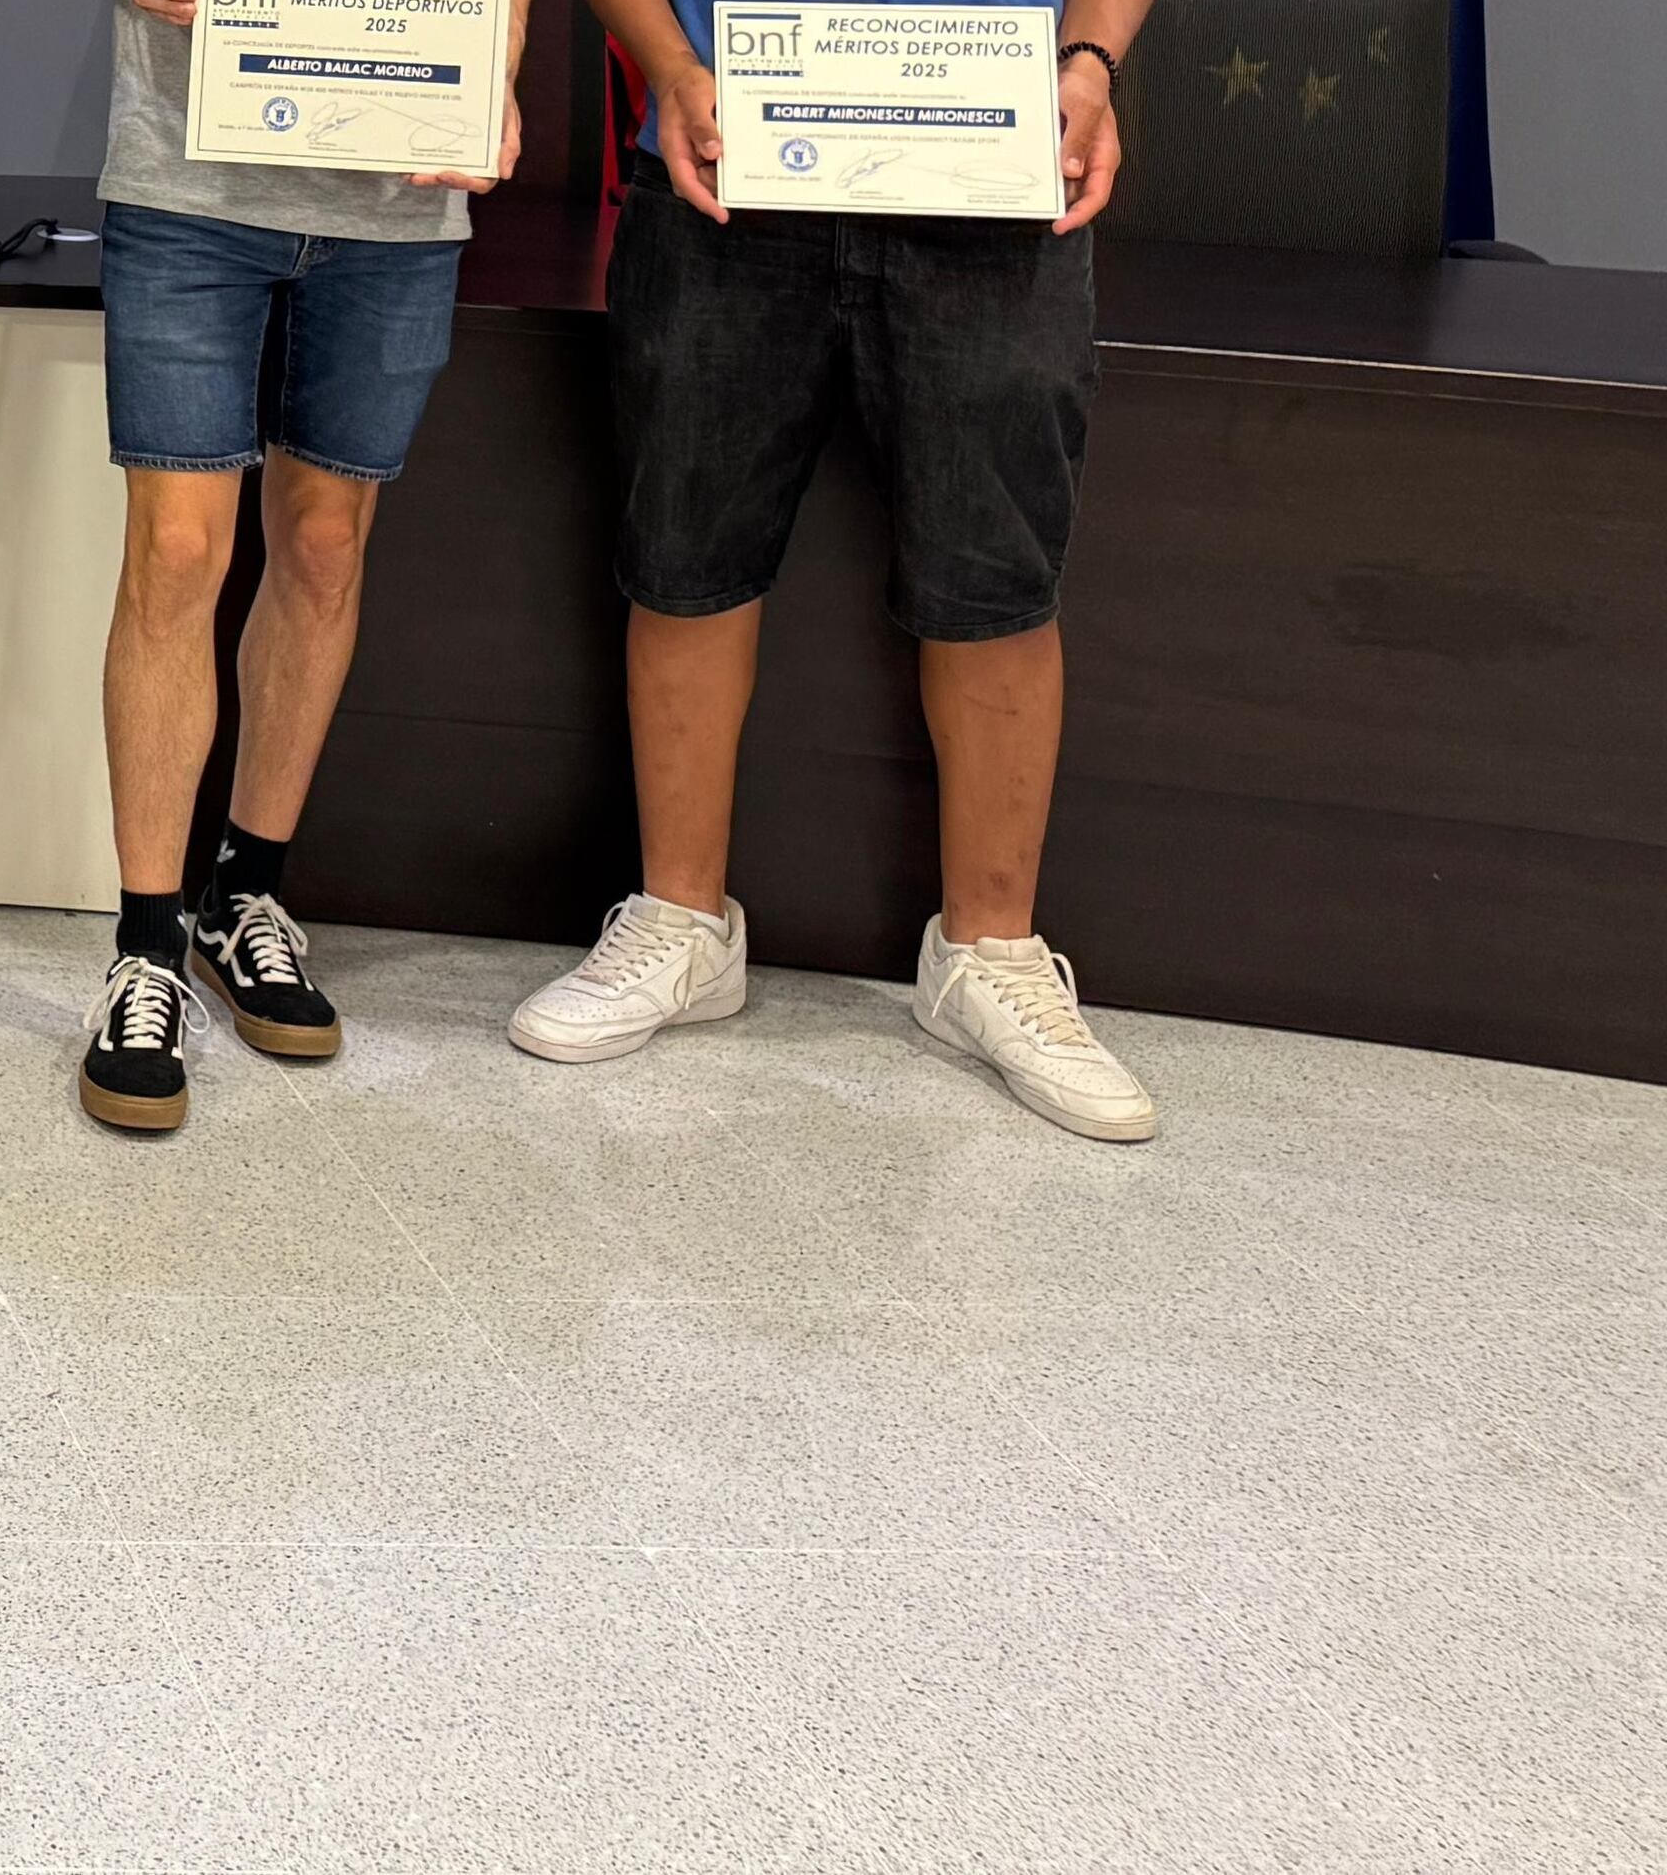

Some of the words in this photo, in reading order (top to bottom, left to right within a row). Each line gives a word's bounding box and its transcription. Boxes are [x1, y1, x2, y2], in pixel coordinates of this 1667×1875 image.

[363, 16, 408, 34] 2025
[826, 17, 1019, 35] RECONOCIMIENTO
[727, 22, 804, 57] bnf
[813, 34, 899, 55] MÉRITOS
[905, 40, 1033, 58] DEPORTIVOS
[266, 57, 322, 73] ALBERTO
[323, 60, 372, 75] BAILAC
[372, 63, 433, 79] MORENO
[900, 61, 948, 78] 2025
[771, 105, 826, 119] ROBERT
[826, 106, 915, 122] MIRONESCU
[916, 108, 1006, 124] MIRONESCU
